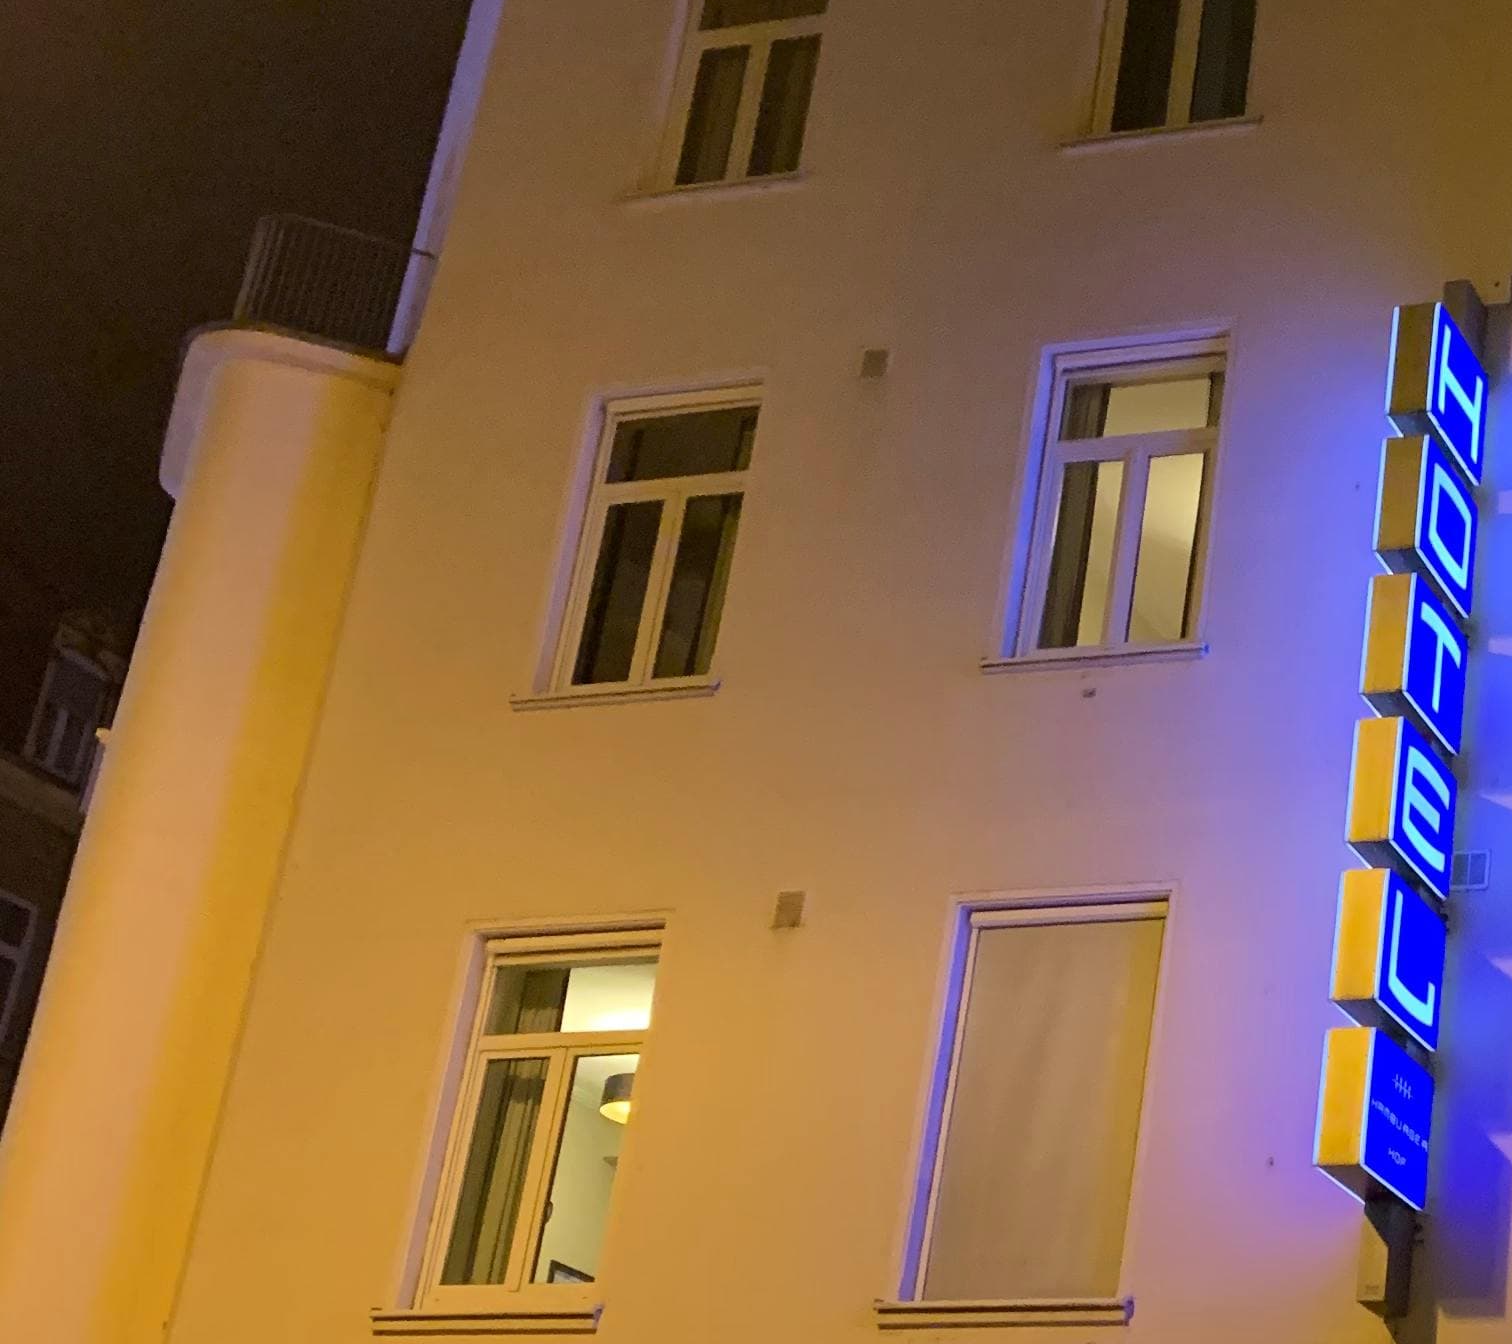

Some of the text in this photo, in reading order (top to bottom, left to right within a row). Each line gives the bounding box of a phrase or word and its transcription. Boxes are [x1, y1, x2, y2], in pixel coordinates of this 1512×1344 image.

[1388, 324, 1483, 1027] HOTEL
[1371, 1098, 1429, 1153] HAMBURGER
[1387, 1146, 1407, 1167] HOF
